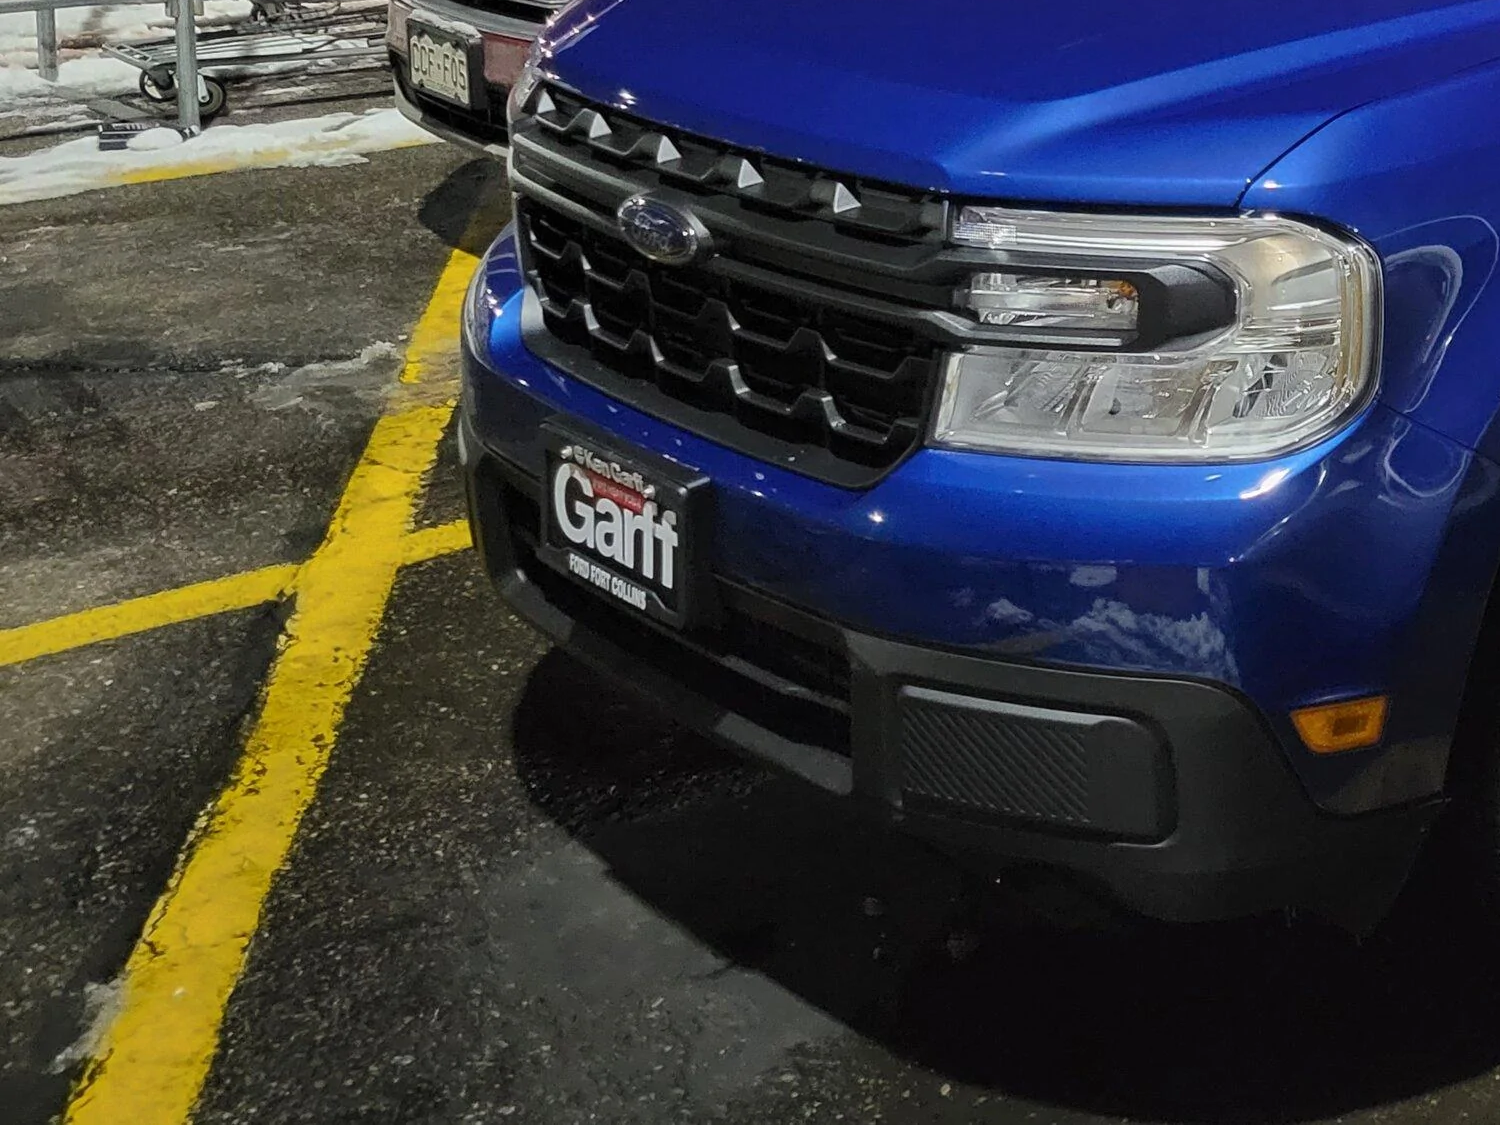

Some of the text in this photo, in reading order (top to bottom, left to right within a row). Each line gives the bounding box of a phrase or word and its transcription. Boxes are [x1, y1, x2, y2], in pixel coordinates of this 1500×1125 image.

[555, 463, 679, 588] Garff
[569, 552, 647, 610] FORD FORT COLLINS
